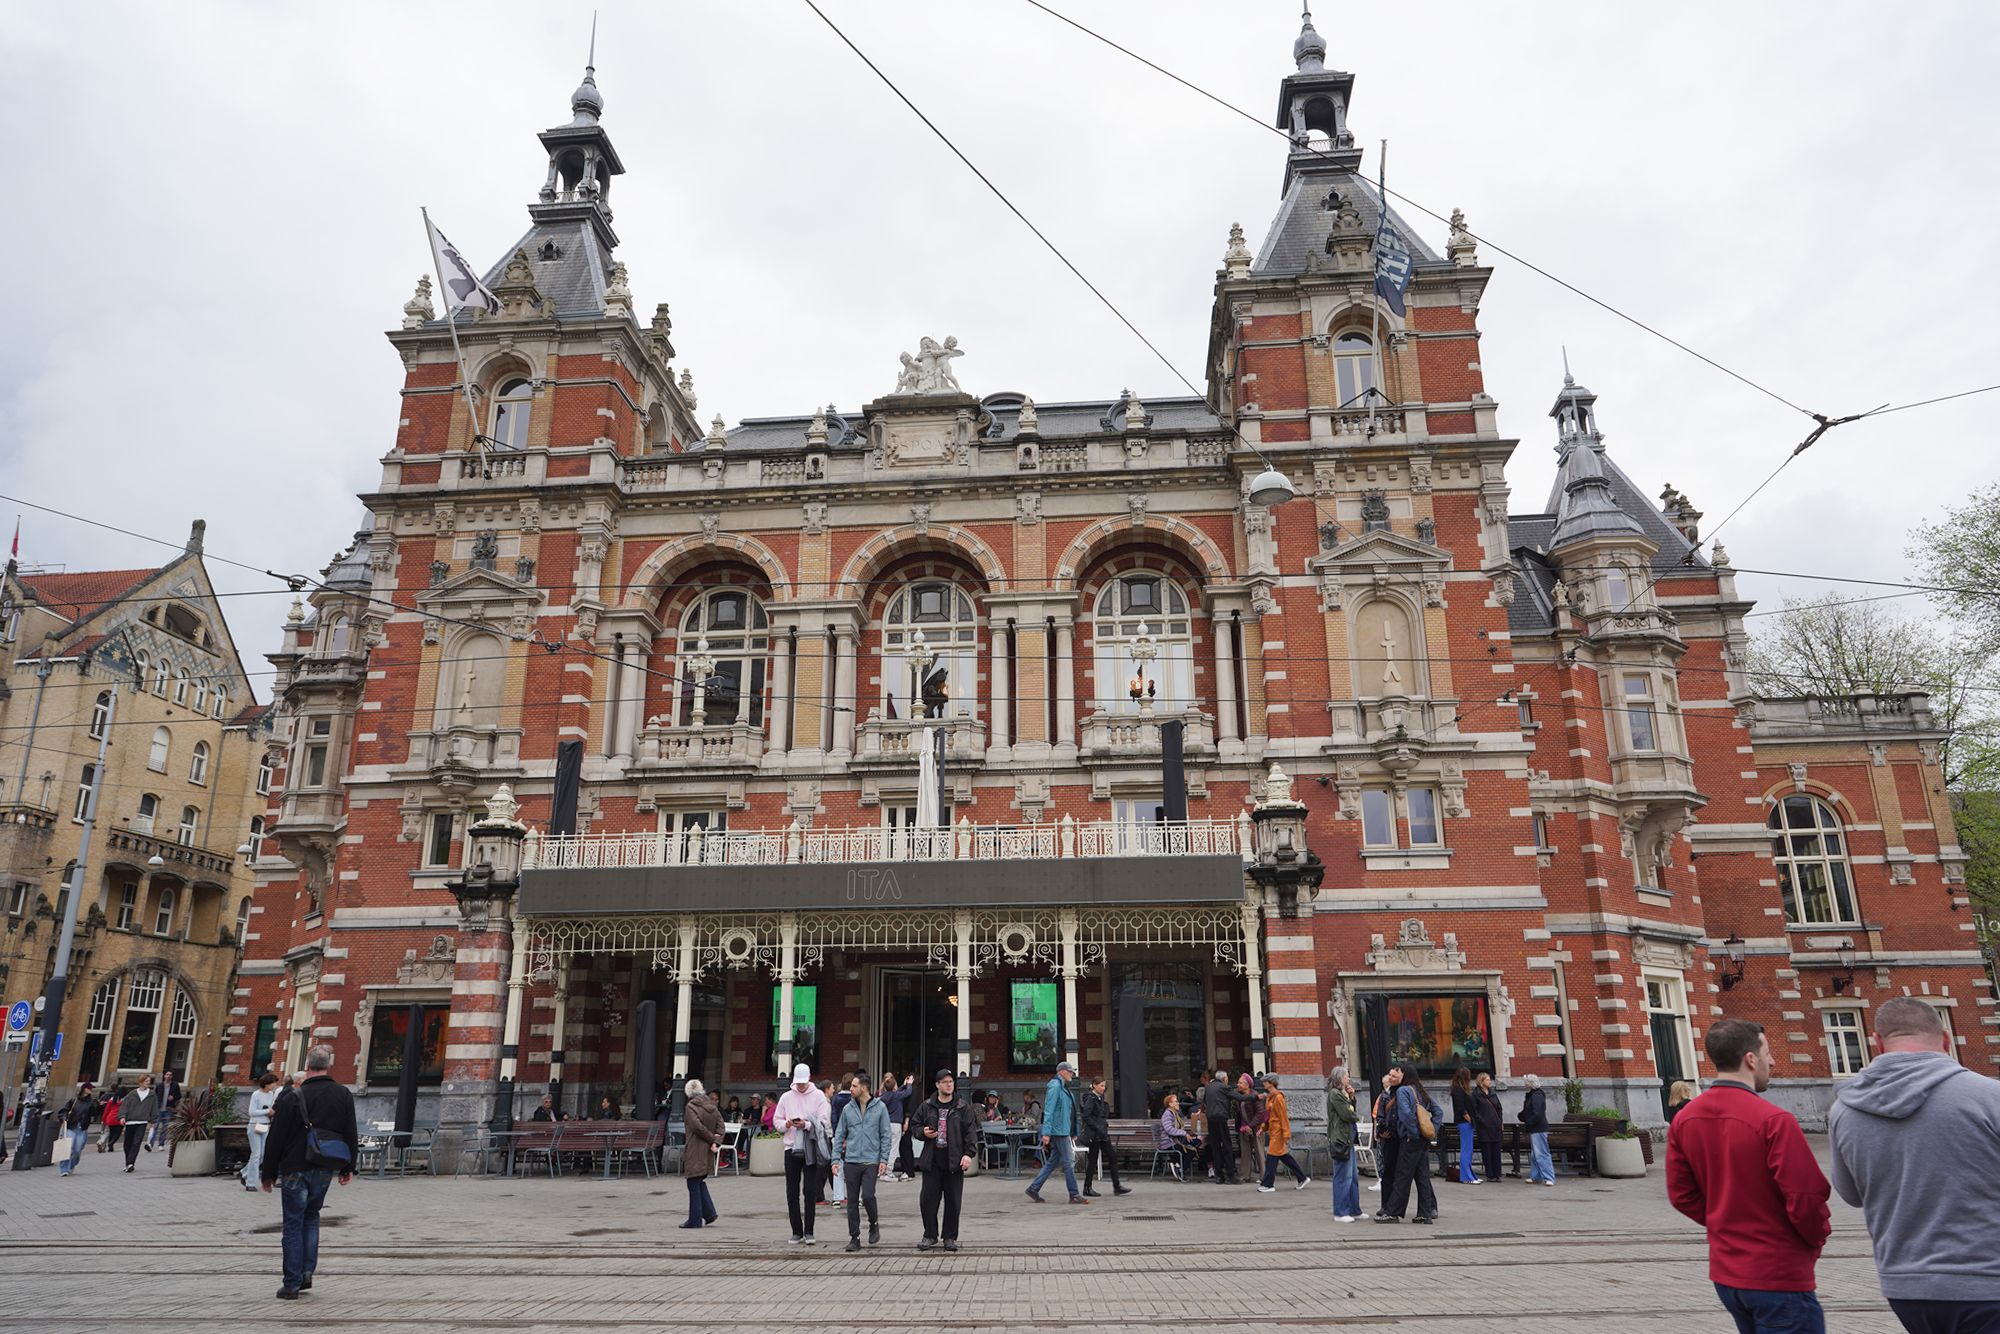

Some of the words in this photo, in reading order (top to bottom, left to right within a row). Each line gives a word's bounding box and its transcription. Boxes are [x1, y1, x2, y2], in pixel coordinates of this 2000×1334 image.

[1380, 620, 1401, 682] ITA
[457, 656, 476, 713] ITA
[846, 868, 903, 901] ITA
